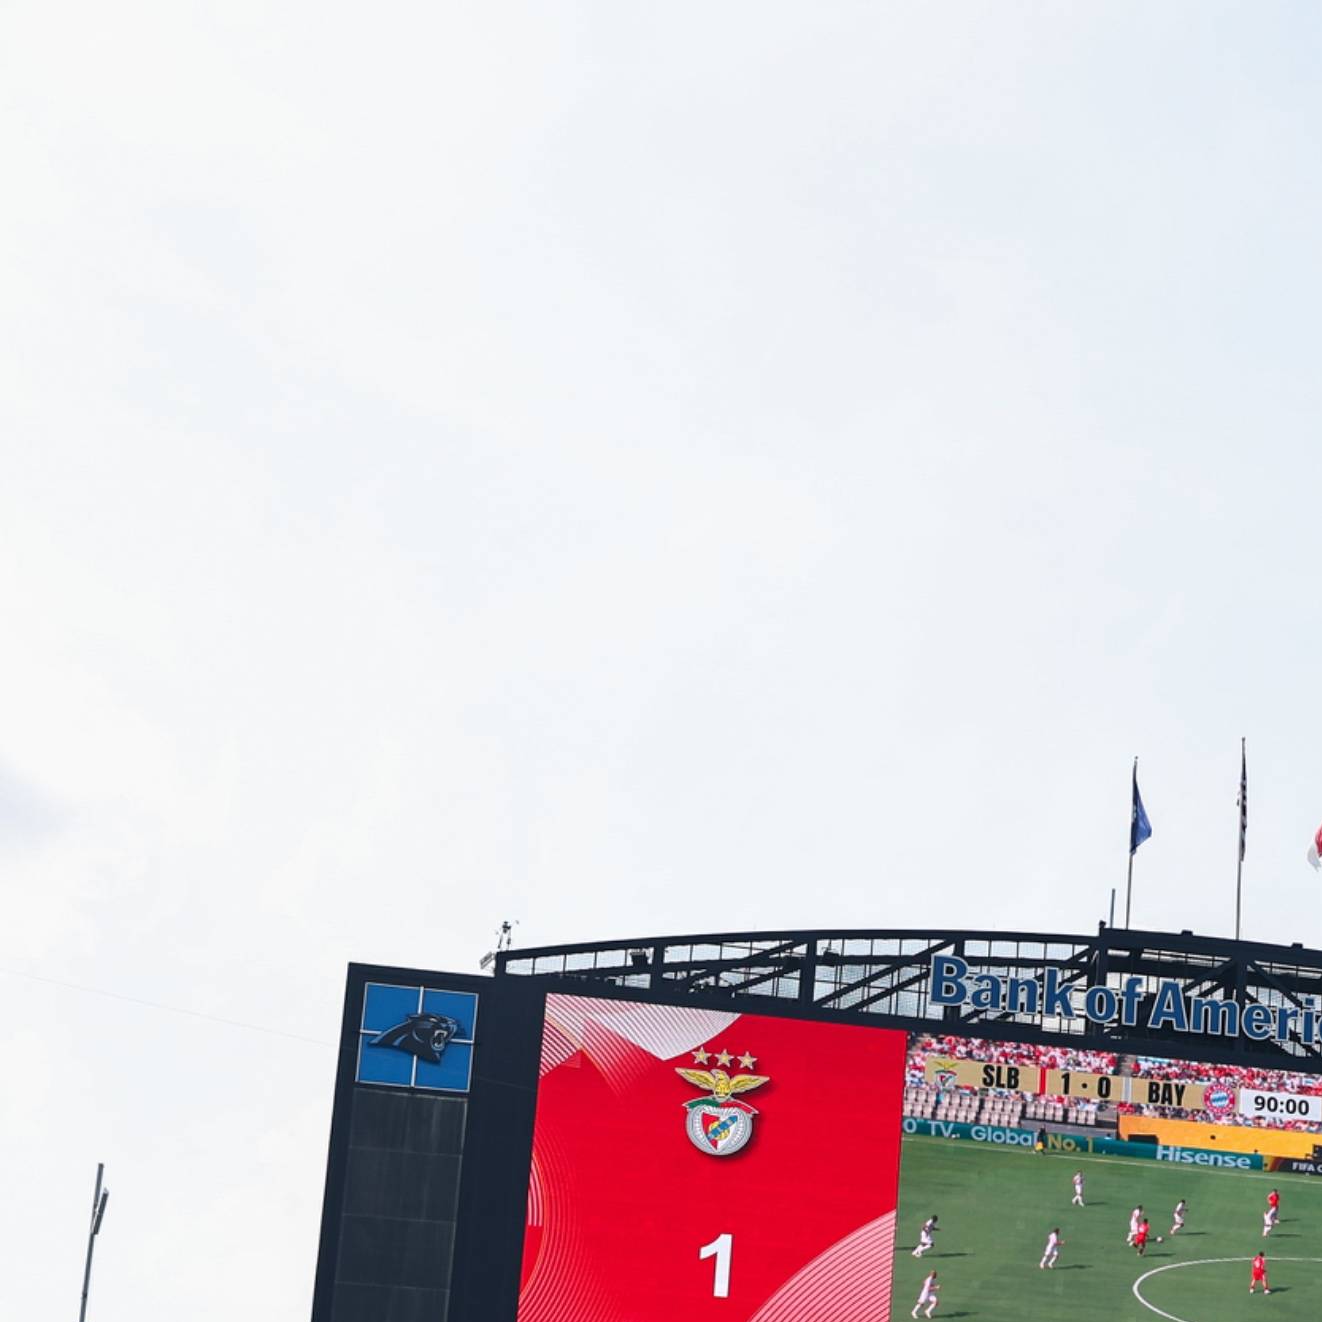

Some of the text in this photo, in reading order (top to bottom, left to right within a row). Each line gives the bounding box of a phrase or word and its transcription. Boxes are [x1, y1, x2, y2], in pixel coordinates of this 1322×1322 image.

[930, 953, 1076, 1019] Bank
[1085, 976, 1145, 1027] of
[982, 1064, 1020, 1089] SLB
[1061, 1073, 1070, 1094] 1
[1097, 1076, 1111, 1098] 0
[1148, 1082, 1186, 1106] BAY
[1254, 1095, 1309, 1116] 90:00
[1049, 1135, 1082, 1151] No.
[1157, 1145, 1251, 1169] Hisense
[1292, 1162, 1315, 1173] FIFA
[700, 1233, 732, 1298] 1
